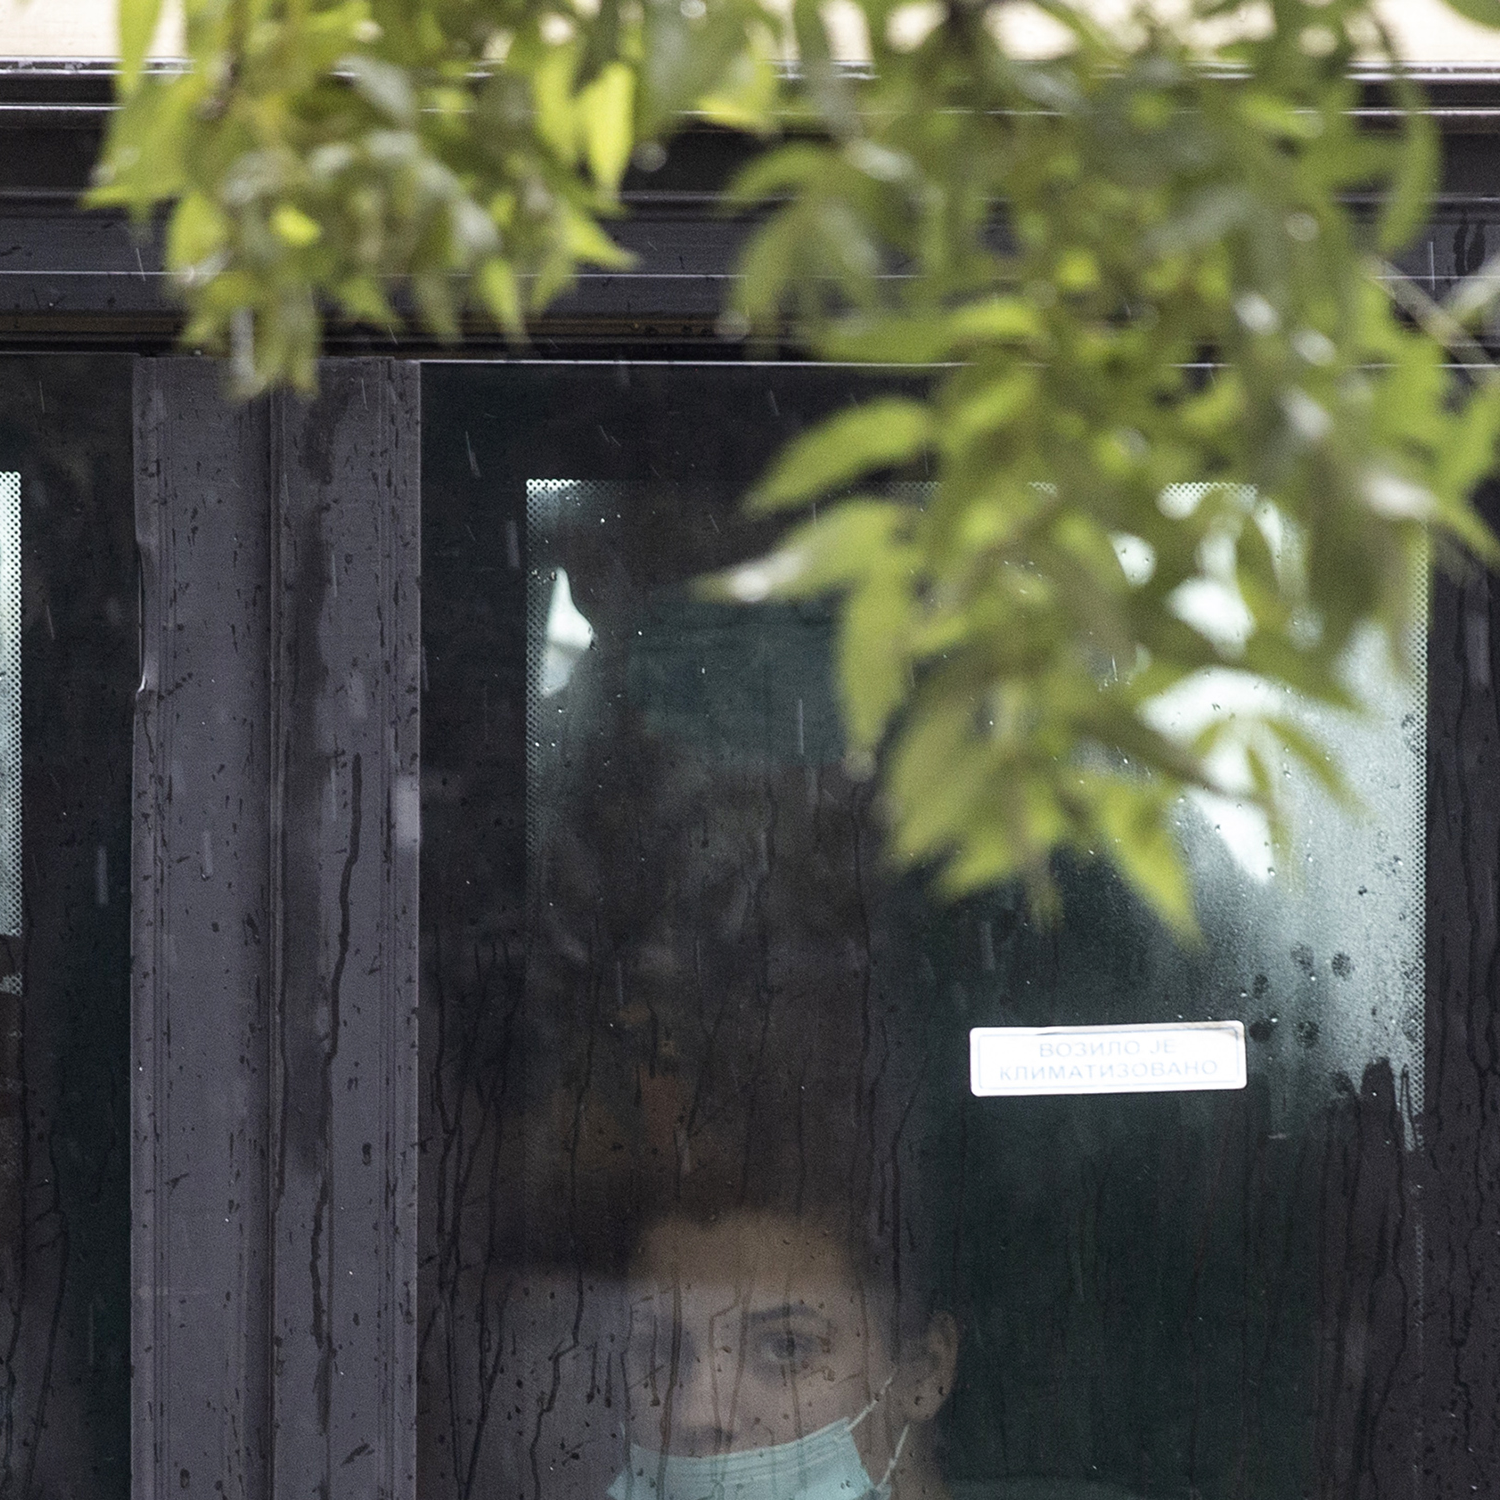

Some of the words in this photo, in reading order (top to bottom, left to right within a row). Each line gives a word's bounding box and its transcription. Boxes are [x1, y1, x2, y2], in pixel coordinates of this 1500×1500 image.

[1040, 1042, 1140, 1058] ВОЗИЛО
[1150, 1039, 1176, 1054] ЈЕ
[1000, 1060, 1218, 1081] КЛИМАТИЗОВАНО
